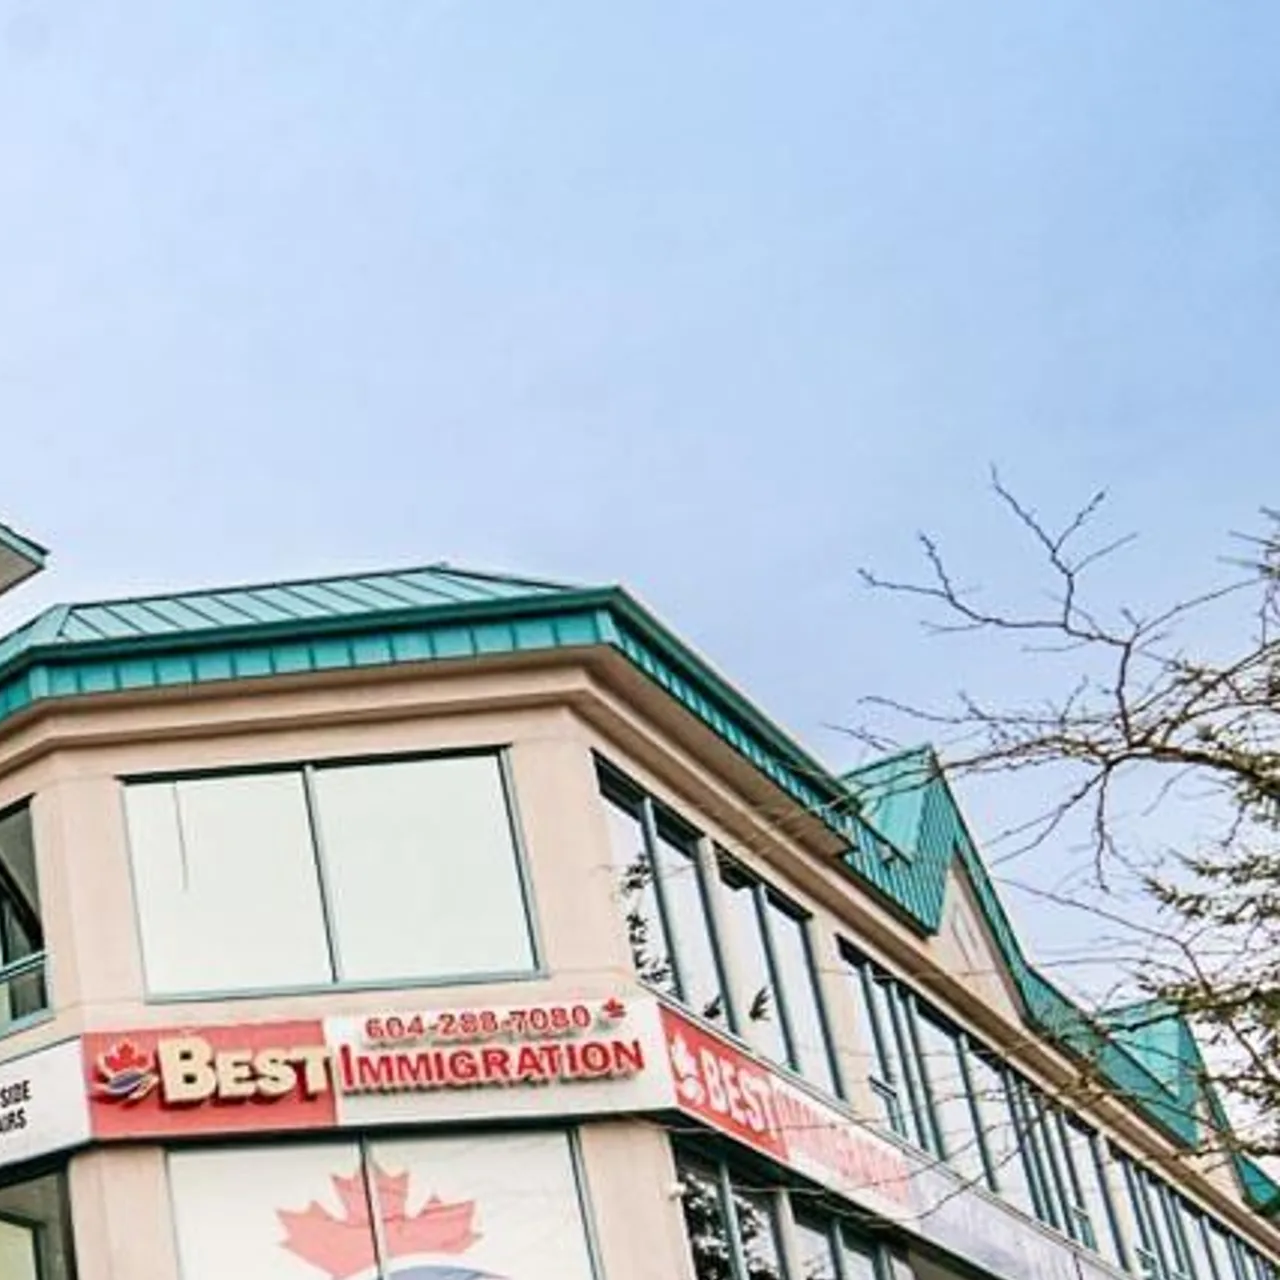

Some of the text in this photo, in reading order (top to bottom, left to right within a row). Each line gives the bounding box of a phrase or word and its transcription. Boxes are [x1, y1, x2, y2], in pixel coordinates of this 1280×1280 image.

[365, 1003, 593, 1042] 604-288-7080
[340, 1040, 644, 1091] IMMIGRATION
[0, 1080, 31, 1108] SIDE
